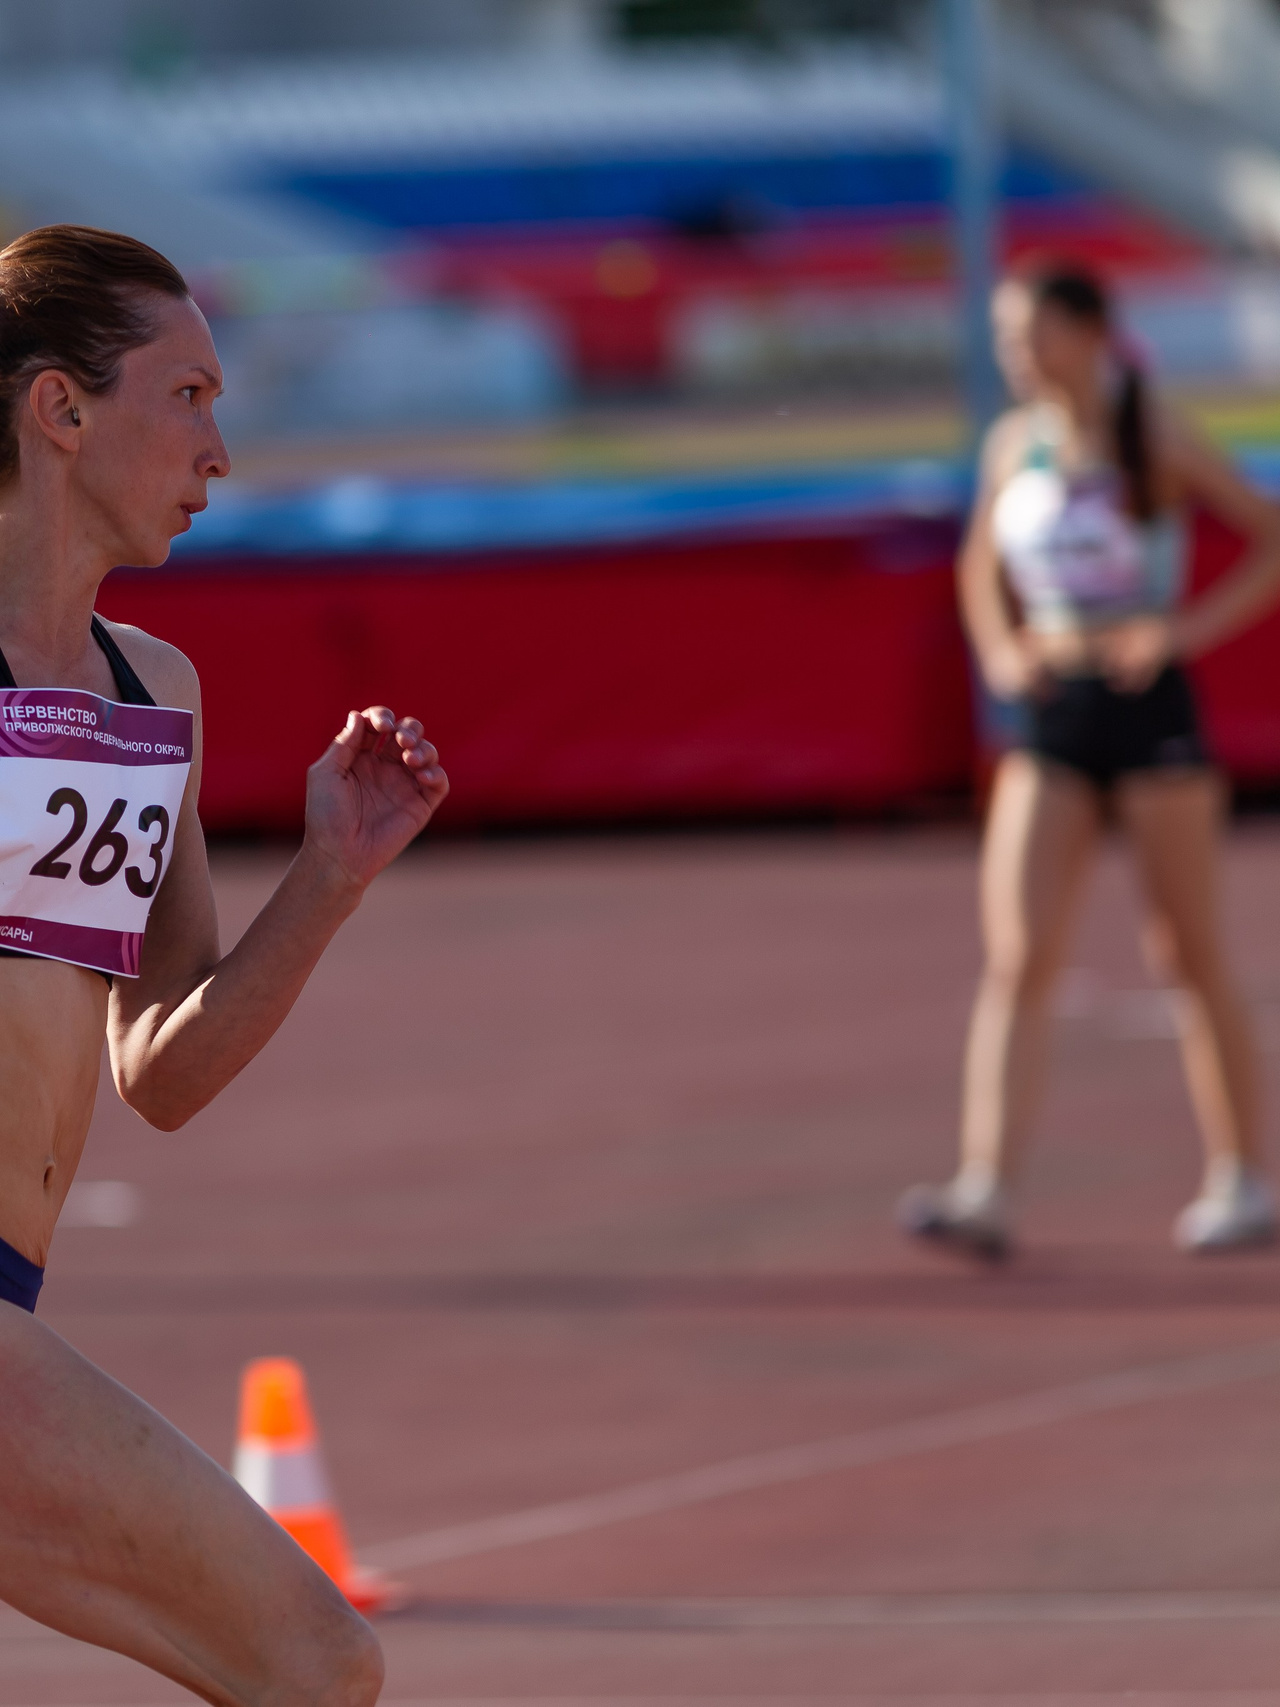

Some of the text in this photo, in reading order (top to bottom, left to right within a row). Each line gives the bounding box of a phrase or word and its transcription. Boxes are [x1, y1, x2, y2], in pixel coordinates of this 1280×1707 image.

[2, 705, 97, 726] ПЕРВЕНСТВО
[5, 721, 93, 740] ПРИВОЛЖСКОГО
[154, 743, 185, 757] ОКРУГА
[29, 787, 169, 898] 263
